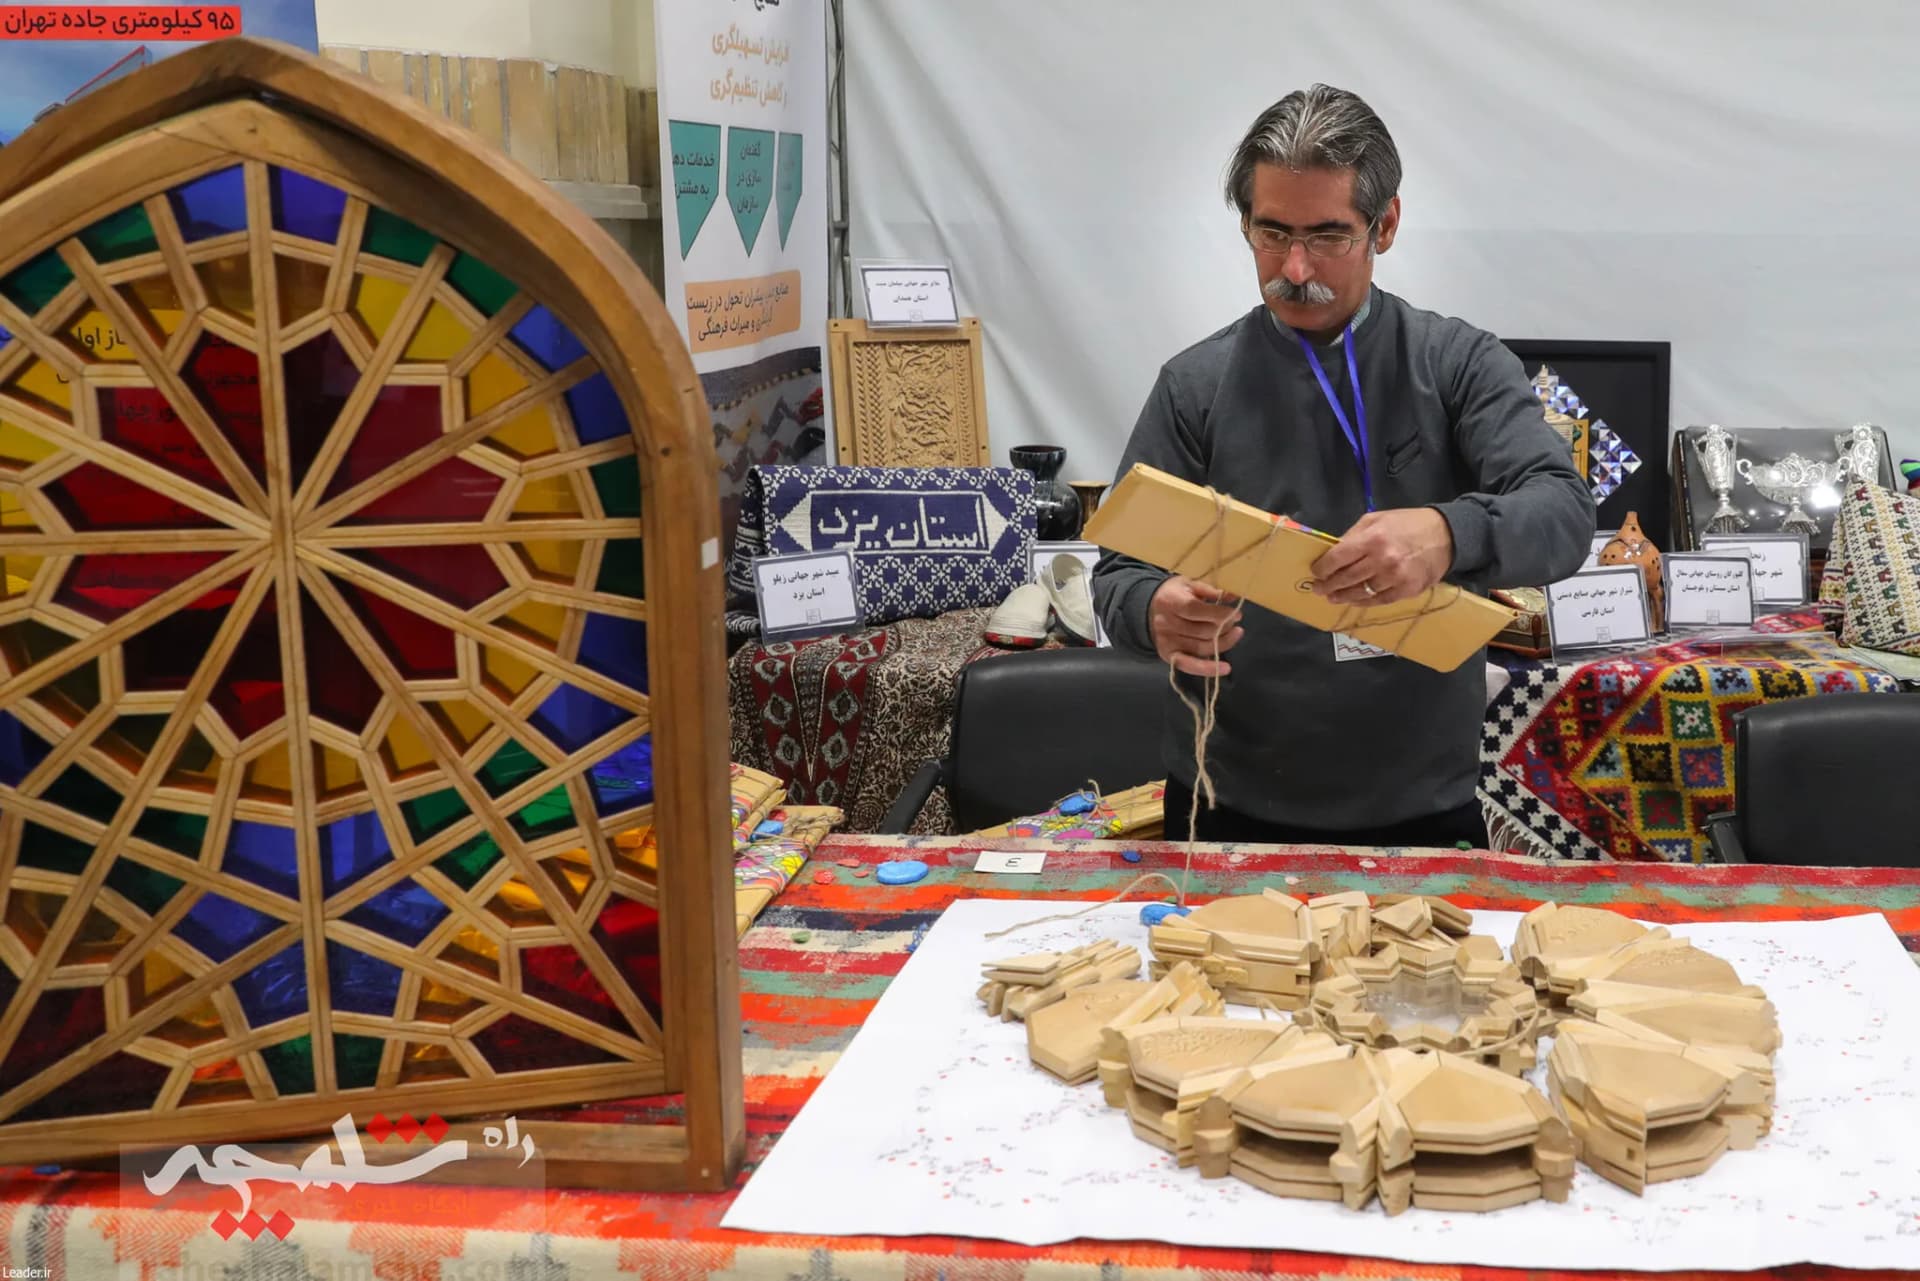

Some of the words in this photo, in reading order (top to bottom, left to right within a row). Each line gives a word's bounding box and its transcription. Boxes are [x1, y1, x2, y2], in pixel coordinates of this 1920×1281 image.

[5, 8, 57, 34] تهران
[62, 9, 107, 35] جاده
[112, 9, 203, 36] کیلومتری
[207, 12, 235, 31] ۹۵
[687, 152, 715, 167] خدمات
[700, 183, 711, 200] به
[686, 294, 713, 313] زیست
[713, 295, 723, 313] در
[724, 289, 744, 312] تحول
[893, 294, 912, 303] همدان
[913, 294, 929, 303] استان
[697, 315, 728, 342] فرهنگی
[729, 314, 751, 336] میراث
[817, 506, 881, 550] یزد
[884, 496, 987, 549] استان
[772, 574, 787, 585] زیلو
[788, 570, 809, 583] جهانی
[811, 568, 824, 580] شهر
[1770, 568, 1783, 578] شهر
[806, 587, 825, 600] استان
[1572, 590, 1589, 601] صنایع
[1590, 588, 1607, 599] جهانی
[1682, 585, 1705, 593] بلوچستان
[1709, 585, 1727, 593] سیستان
[1727, 585, 1741, 593] استان
[792, 591, 805, 601] یزد
[1556, 591, 1573, 601] دستی
[1600, 607, 1615, 617] استان
